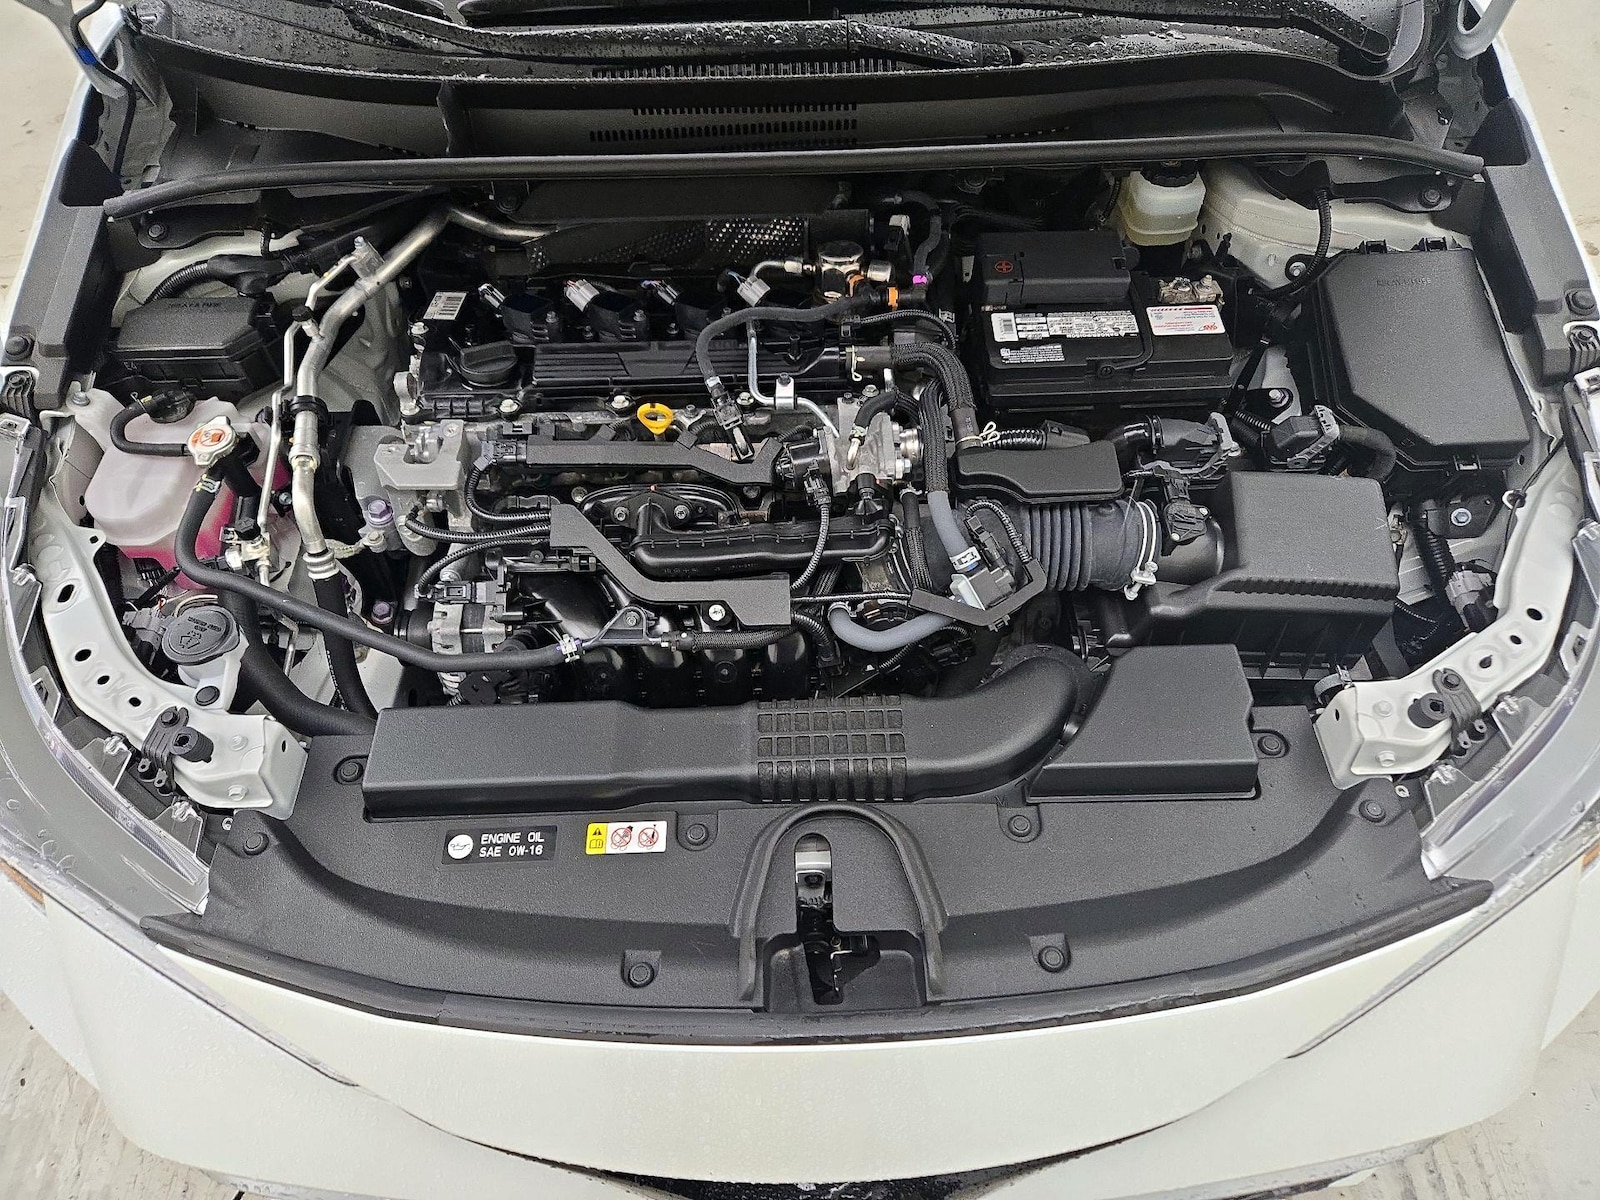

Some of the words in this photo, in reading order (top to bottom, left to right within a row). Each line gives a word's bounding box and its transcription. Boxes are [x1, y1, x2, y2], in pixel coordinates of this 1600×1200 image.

[480, 832, 521, 844] ENGINE
[527, 831, 545, 843] OIL
[479, 846, 502, 857] SAE
[508, 845, 543, 856] 0W-16
